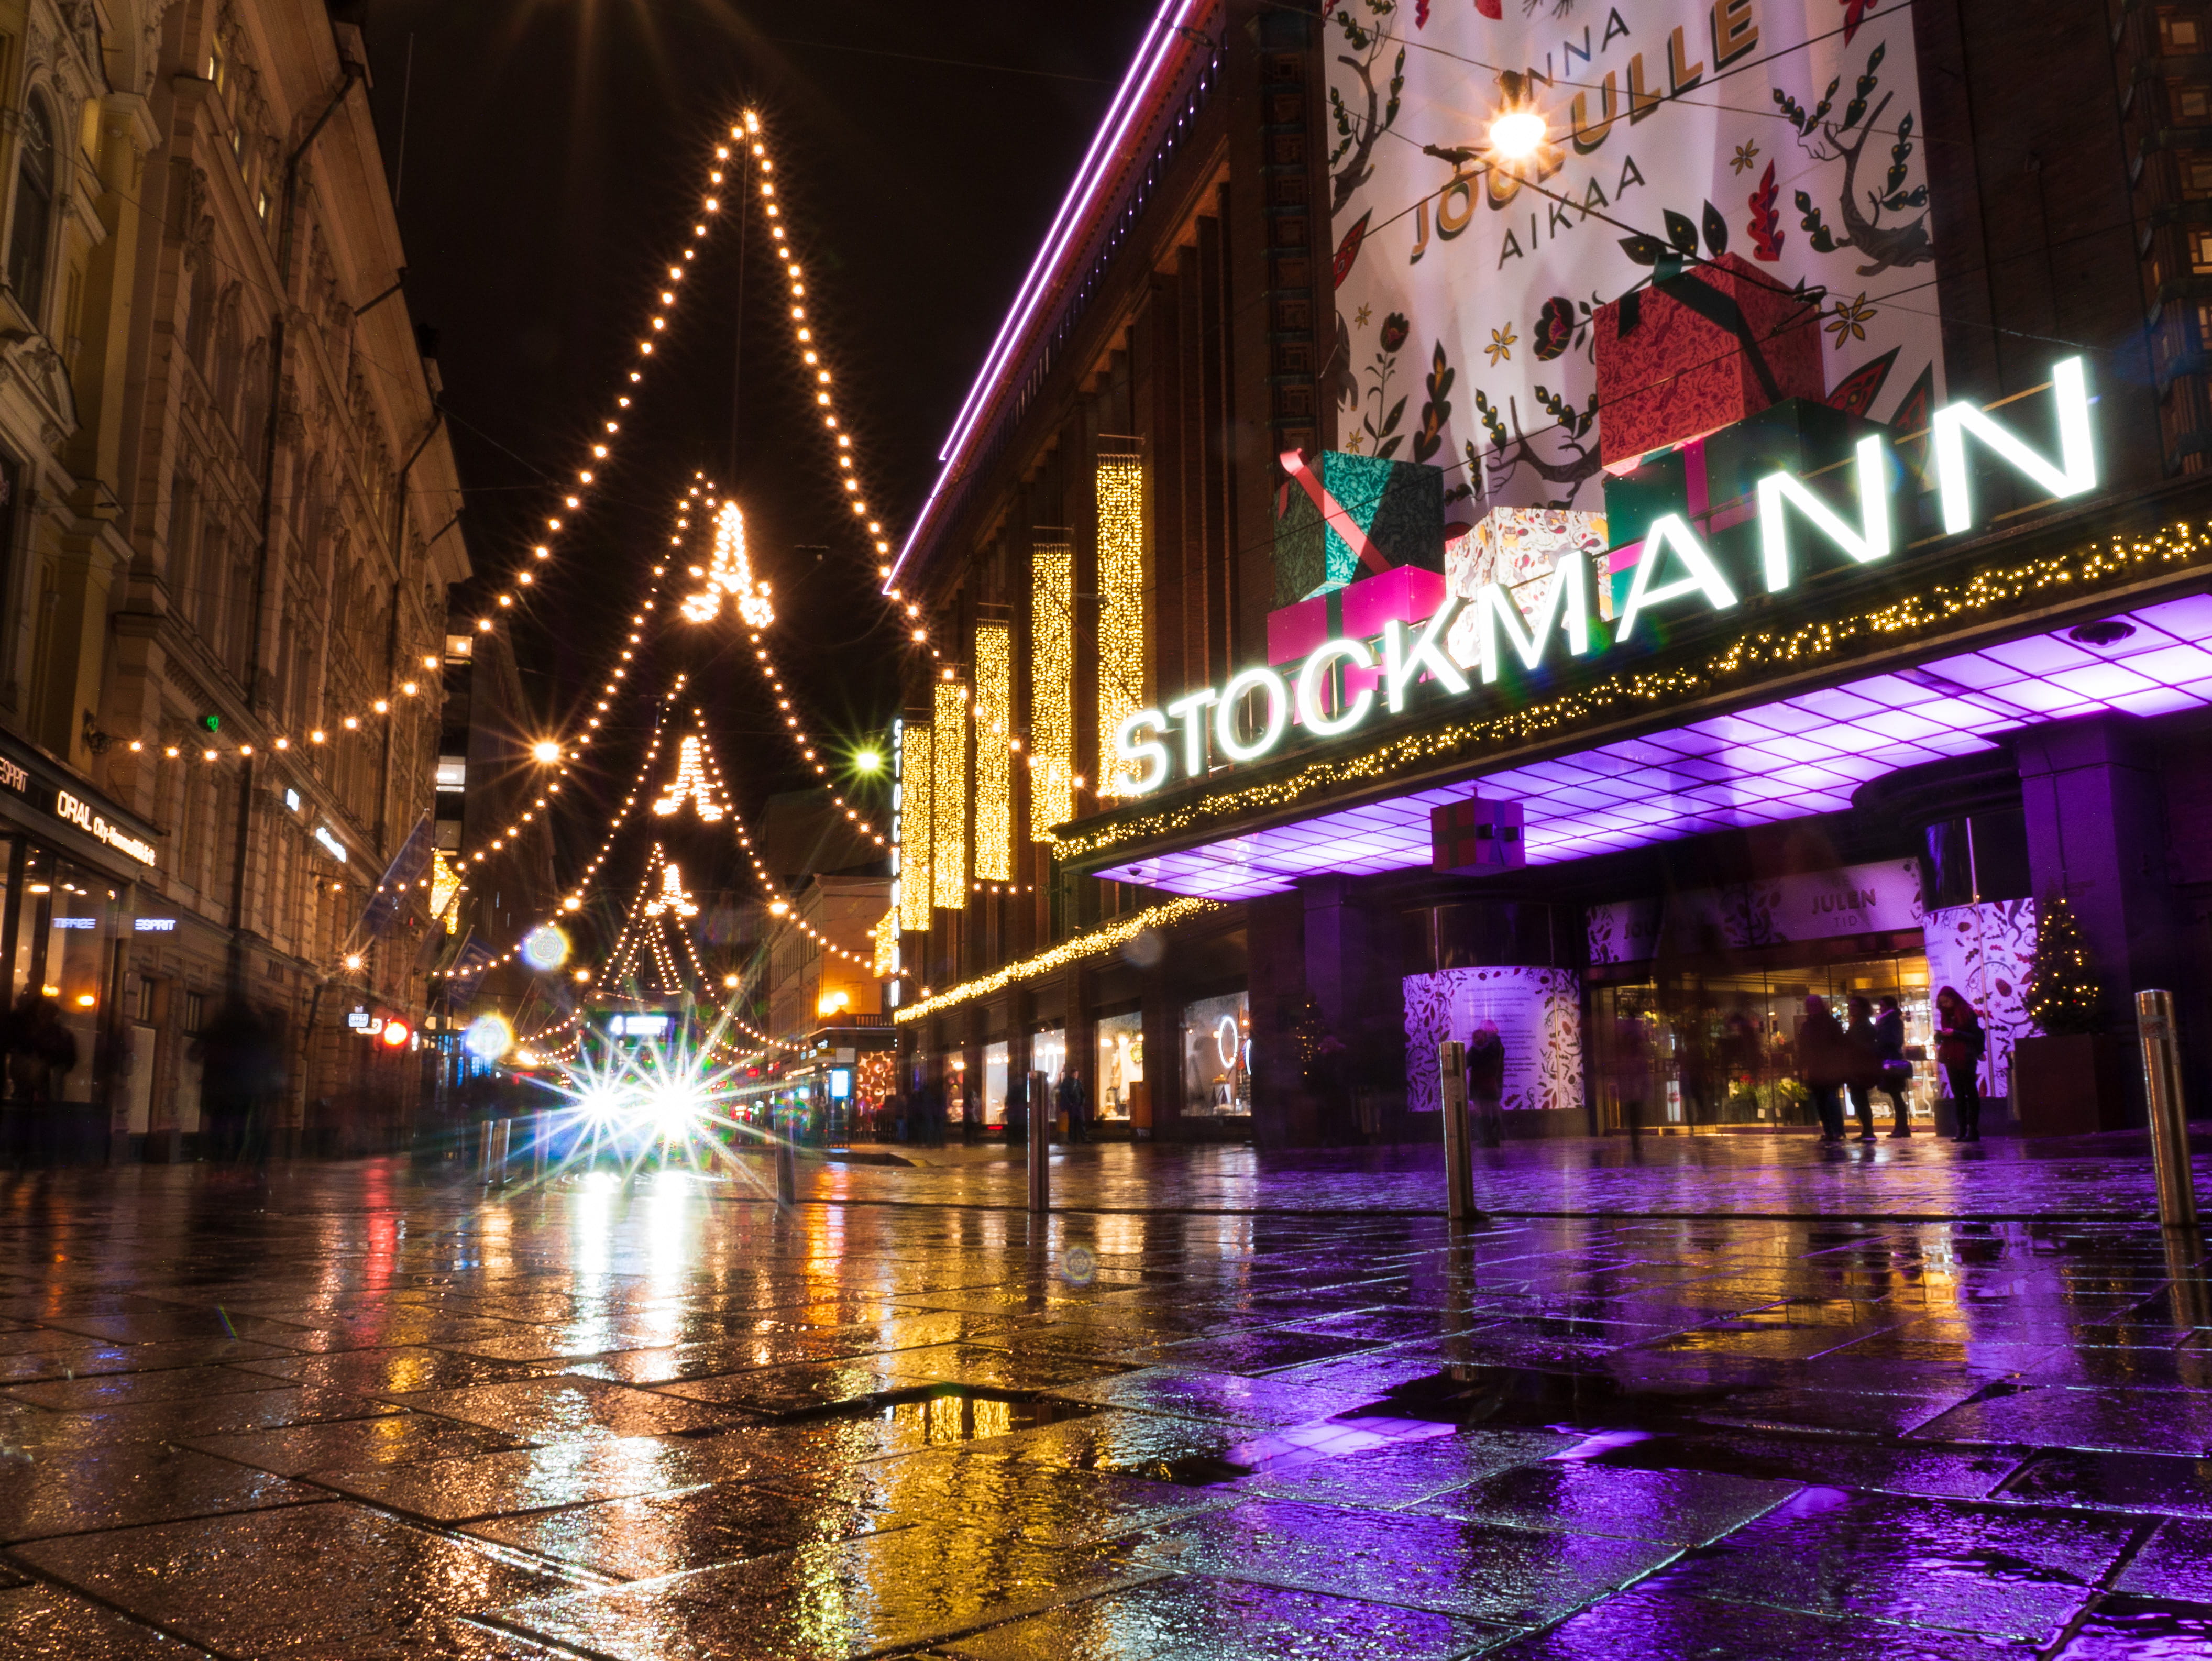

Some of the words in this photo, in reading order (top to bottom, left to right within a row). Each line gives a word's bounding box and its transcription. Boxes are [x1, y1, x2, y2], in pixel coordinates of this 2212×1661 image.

[1498, 155, 1645, 270] AIKAA
[1114, 356, 2098, 798] STOCKMANN
[57, 790, 93, 831] ORAL
[1812, 887, 1876, 915] JULEN
[135, 919, 177, 930] ESPRIT
[1833, 915, 1858, 927] TID
